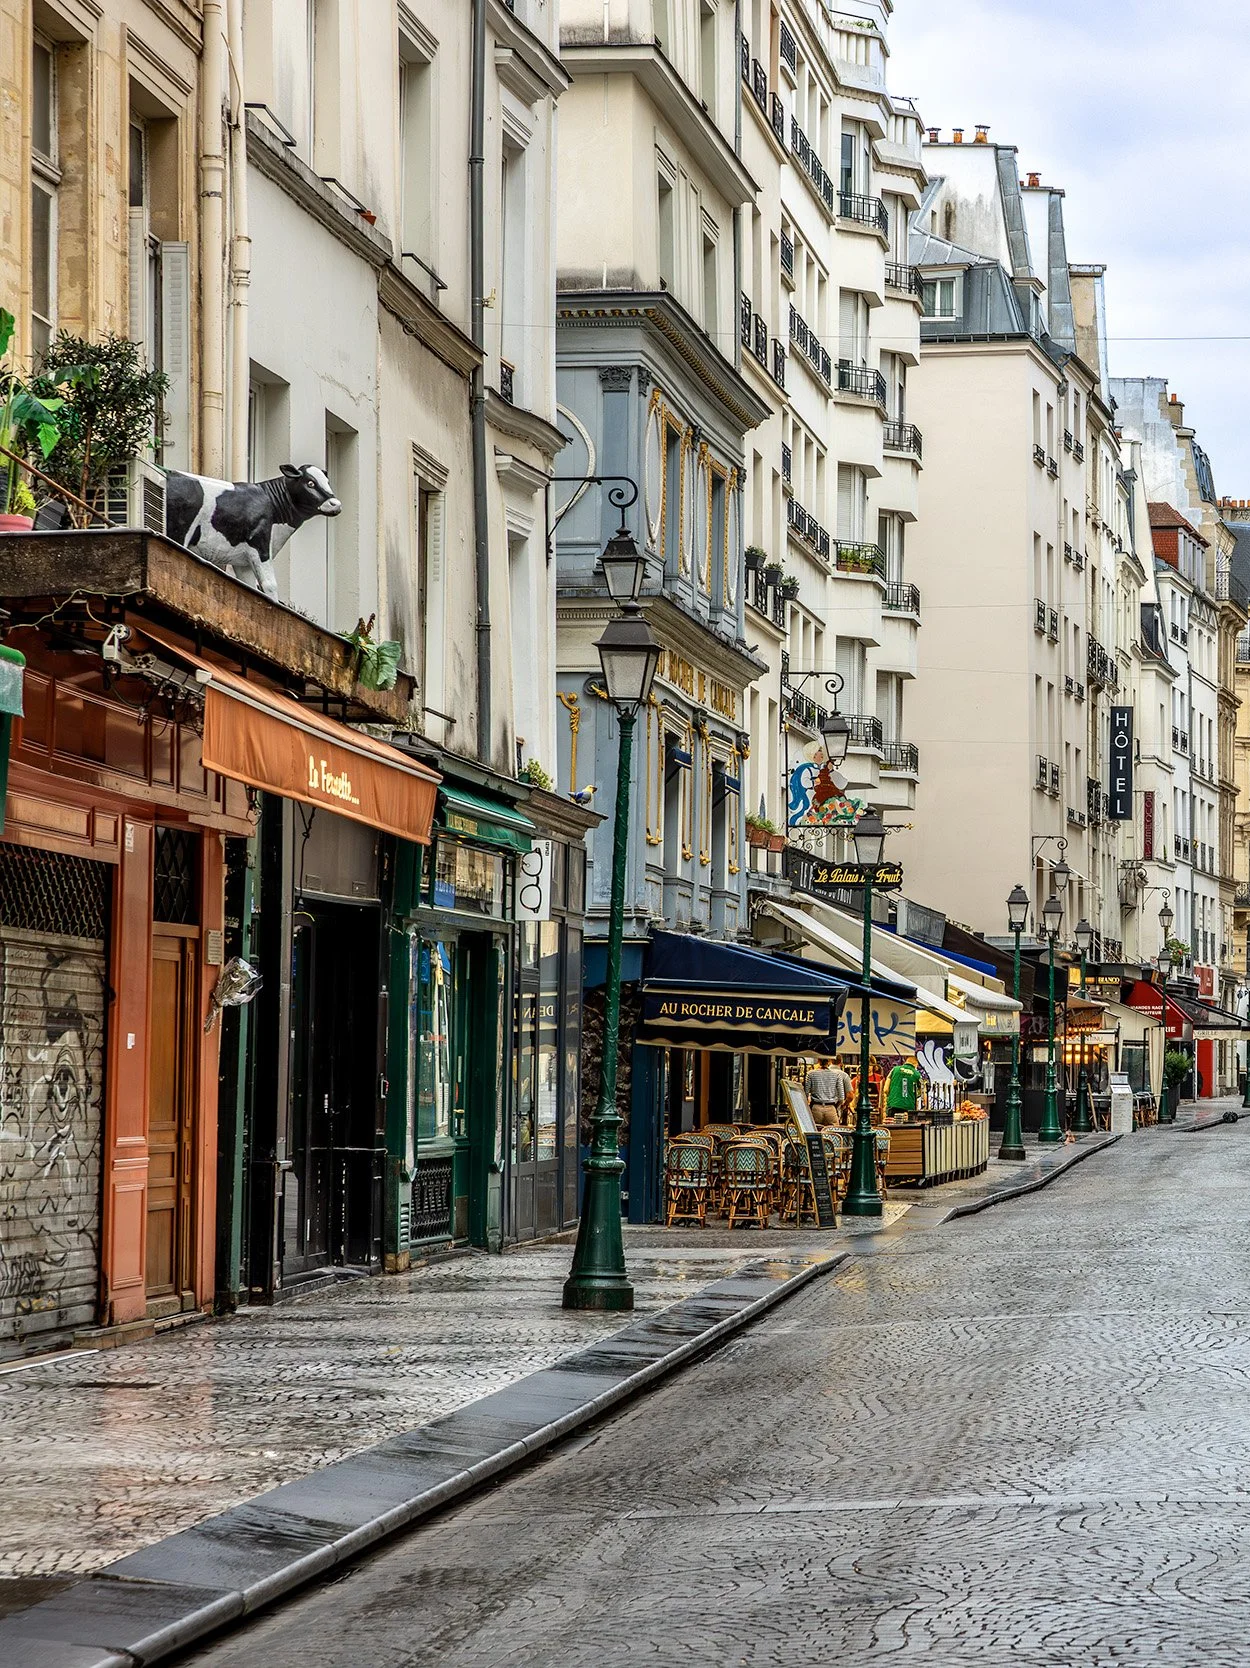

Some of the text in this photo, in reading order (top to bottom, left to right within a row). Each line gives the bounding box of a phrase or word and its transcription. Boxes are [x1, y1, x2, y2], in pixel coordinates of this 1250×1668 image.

[1114, 712, 1129, 814] HÔTEL
[814, 868, 828, 883] Le
[829, 868, 859, 883] Palais
[875, 867, 900, 883] Fruit
[660, 1002, 815, 1023] AU ROCHER DE CANCALE
